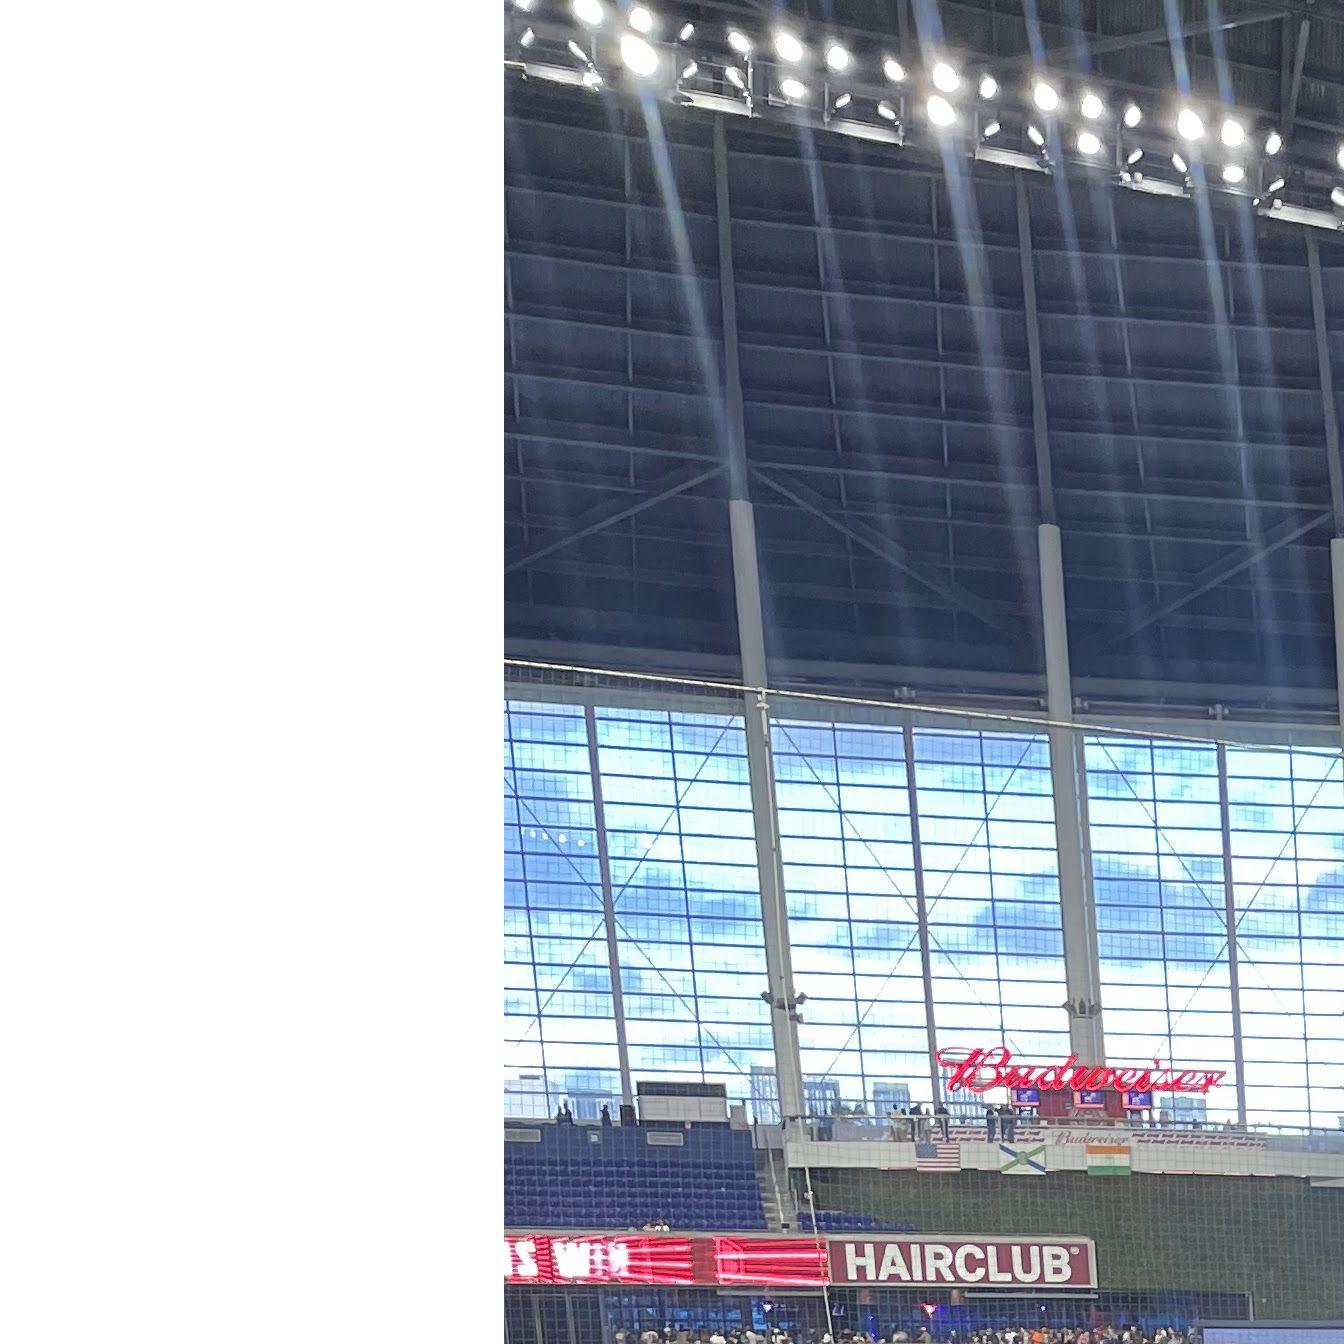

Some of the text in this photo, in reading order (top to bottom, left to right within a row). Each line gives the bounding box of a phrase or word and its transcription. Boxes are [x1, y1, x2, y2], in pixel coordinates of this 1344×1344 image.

[936, 1046, 1226, 1093] Budweiser
[1052, 1130, 1130, 1146] Budweiser
[844, 1243, 1073, 1283] HAIRCLUB
